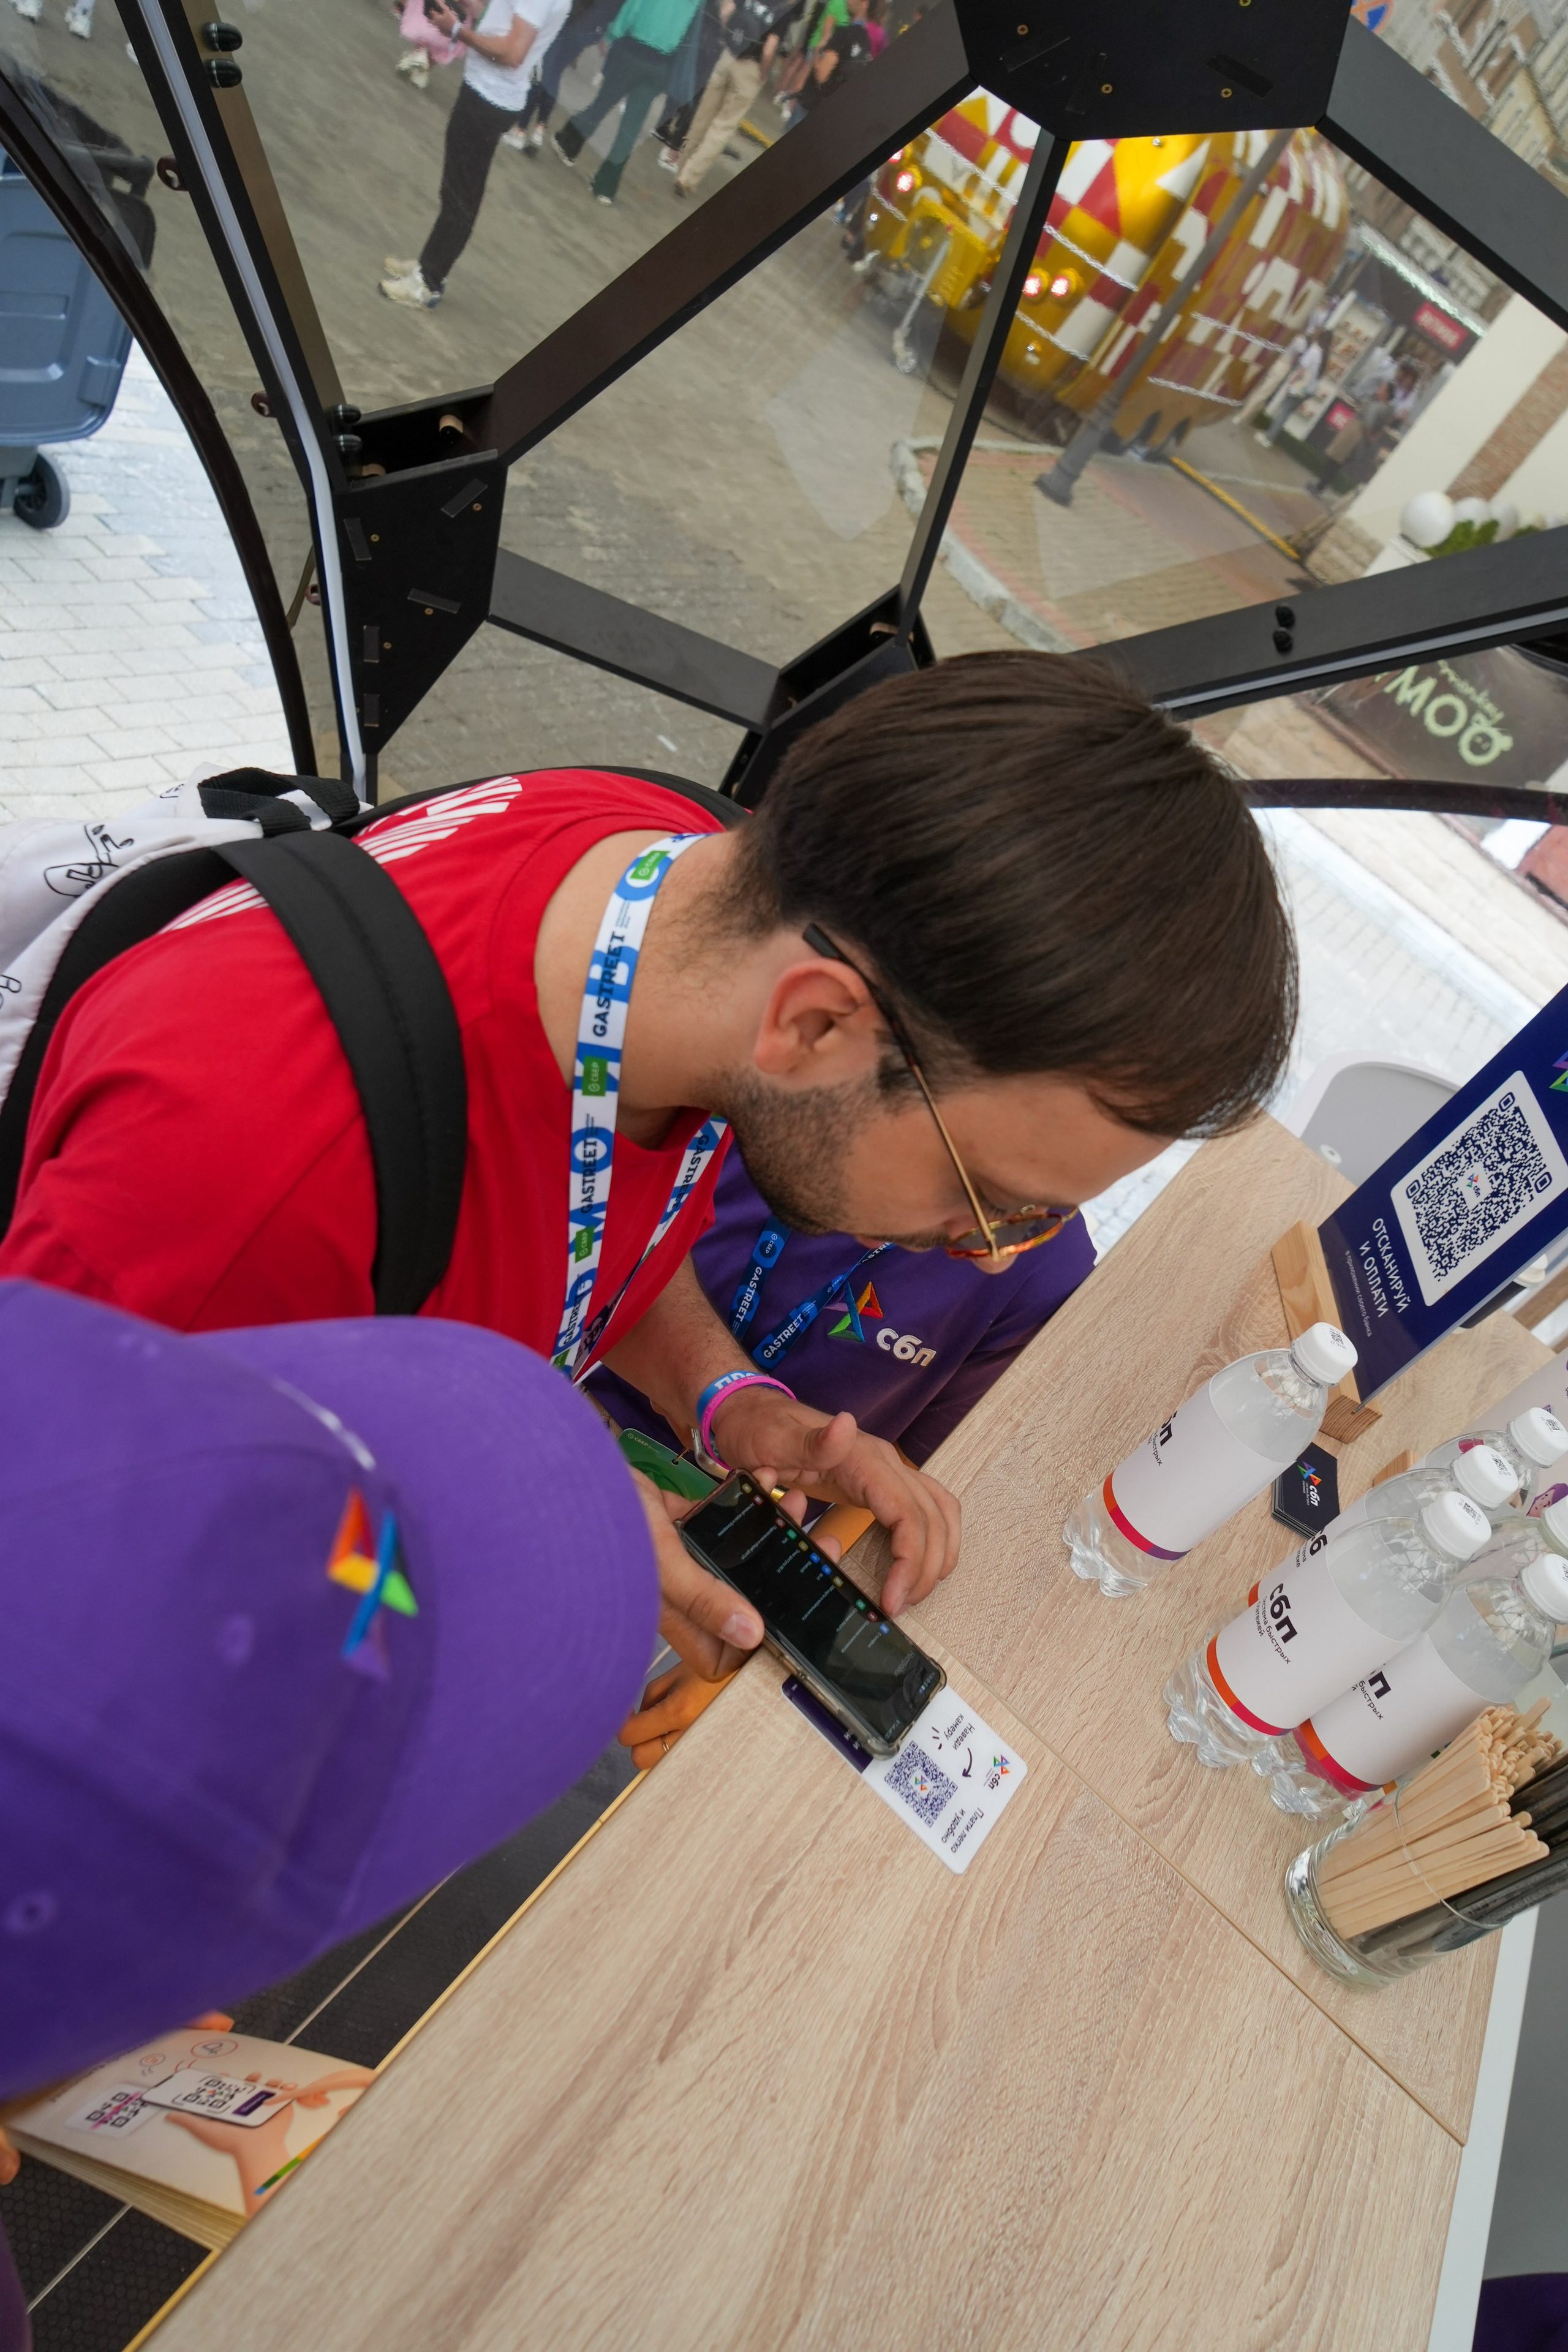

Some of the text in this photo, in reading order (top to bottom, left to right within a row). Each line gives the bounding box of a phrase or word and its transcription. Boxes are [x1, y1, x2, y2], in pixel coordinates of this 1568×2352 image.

[592, 930, 625, 1038] GASTREET
[581, 1139, 597, 1213] GASTREET
[671, 1135, 710, 1208] GASTREET
[764, 1239, 774, 1254] СБЕР
[1373, 1218, 1411, 1313] ОТСКАНИРУЙ
[735, 1265, 763, 1322] GASTREET
[1346, 1255, 1360, 1294] приложении
[1357, 1294, 1366, 1317] своего
[1363, 1316, 1372, 1337] банка
[1359, 1241, 1389, 1317] И ОПЛАТИ
[564, 1292, 584, 1344] GASTREET
[762, 1313, 804, 1359] GASTREET
[876, 1328, 937, 1366] сбп
[633, 1436, 649, 1447] СБЕР
[1310, 1485, 1319, 1506] сбп
[1270, 1583, 1297, 1643] сбп
[892, 1650, 915, 1678] Настройки
[1266, 1626, 1291, 1664] быстрых
[1359, 1680, 1384, 1720] быстрых
[944, 1714, 964, 1740] камеру
[952, 1723, 975, 1750] Наведи
[989, 1773, 1000, 1790] сбп
[941, 1813, 962, 1843] удобно
[951, 1807, 984, 1853] Плати легко
